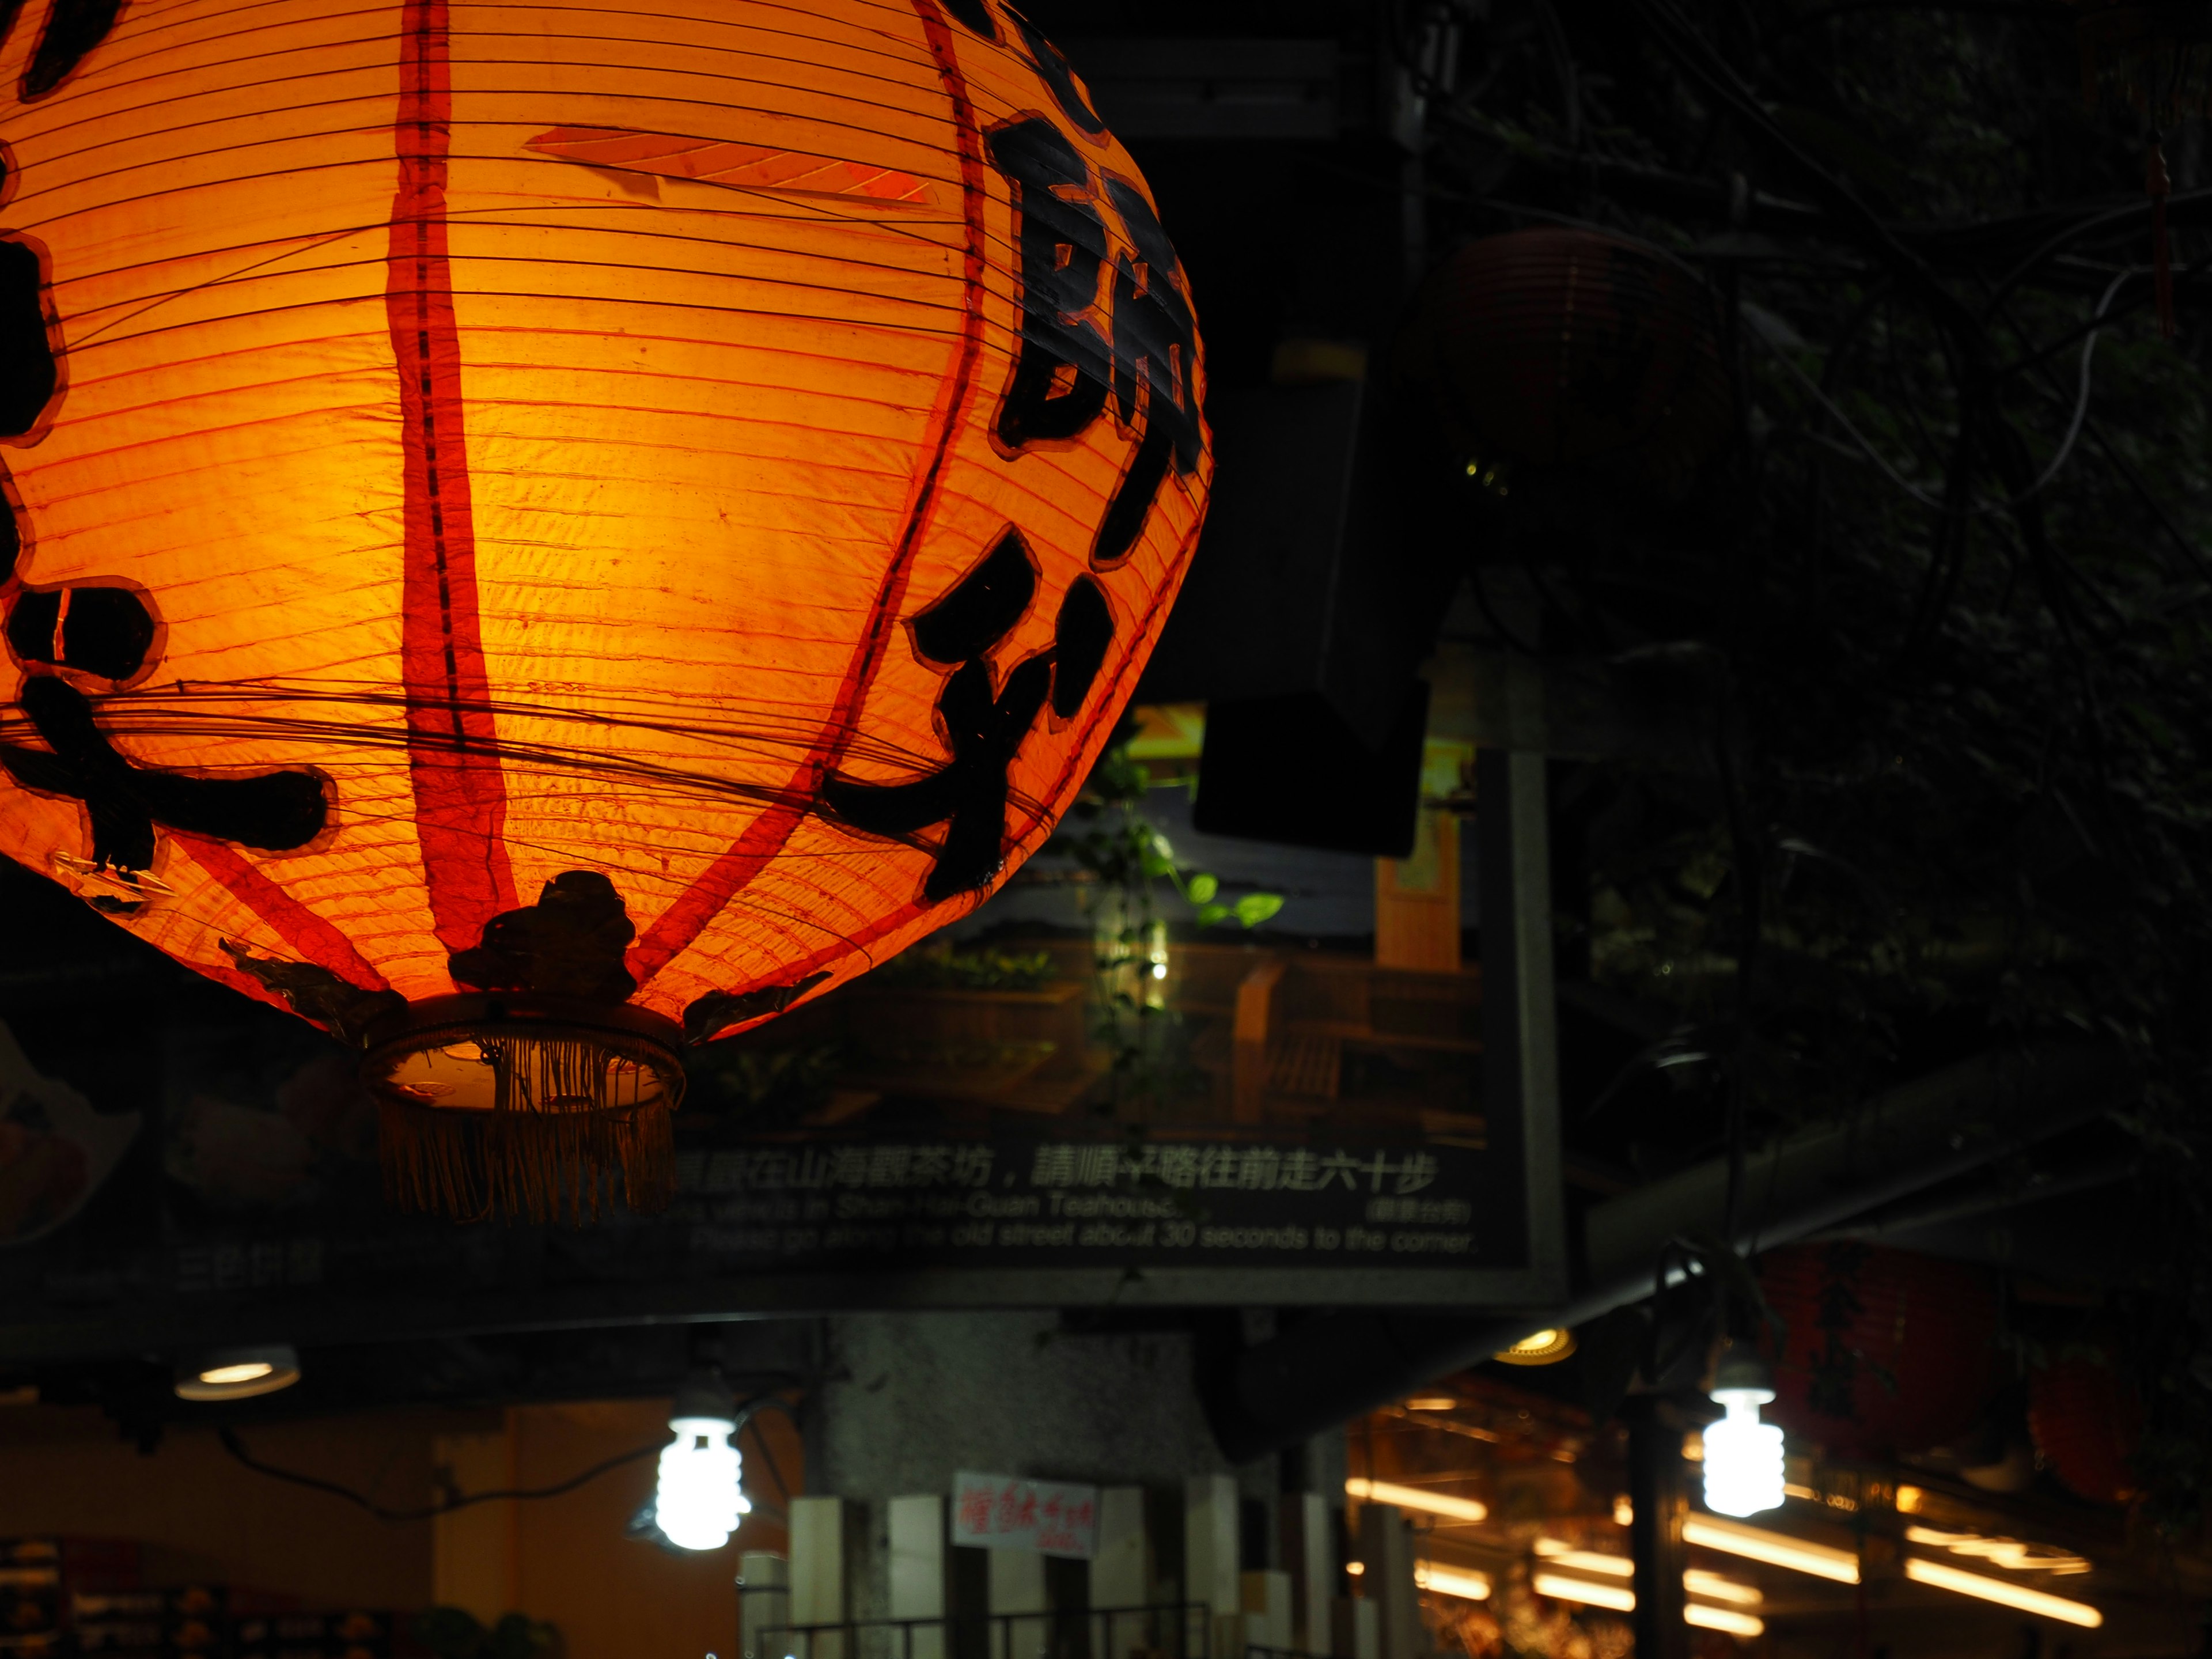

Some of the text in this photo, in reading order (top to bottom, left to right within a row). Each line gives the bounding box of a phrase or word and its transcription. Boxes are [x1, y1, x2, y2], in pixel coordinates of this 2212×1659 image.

[803, 1196, 830, 1221] in
[690, 1226, 779, 1252] Please
[782, 1228, 819, 1255] go
[822, 1225, 897, 1253] along
[949, 1219, 995, 1247] old
[998, 1218, 1076, 1247] street
[1159, 1218, 1196, 1247] 30
[1199, 1222, 1309, 1250] seconds
[1312, 1224, 1341, 1251] to
[1344, 1224, 1387, 1251] the
